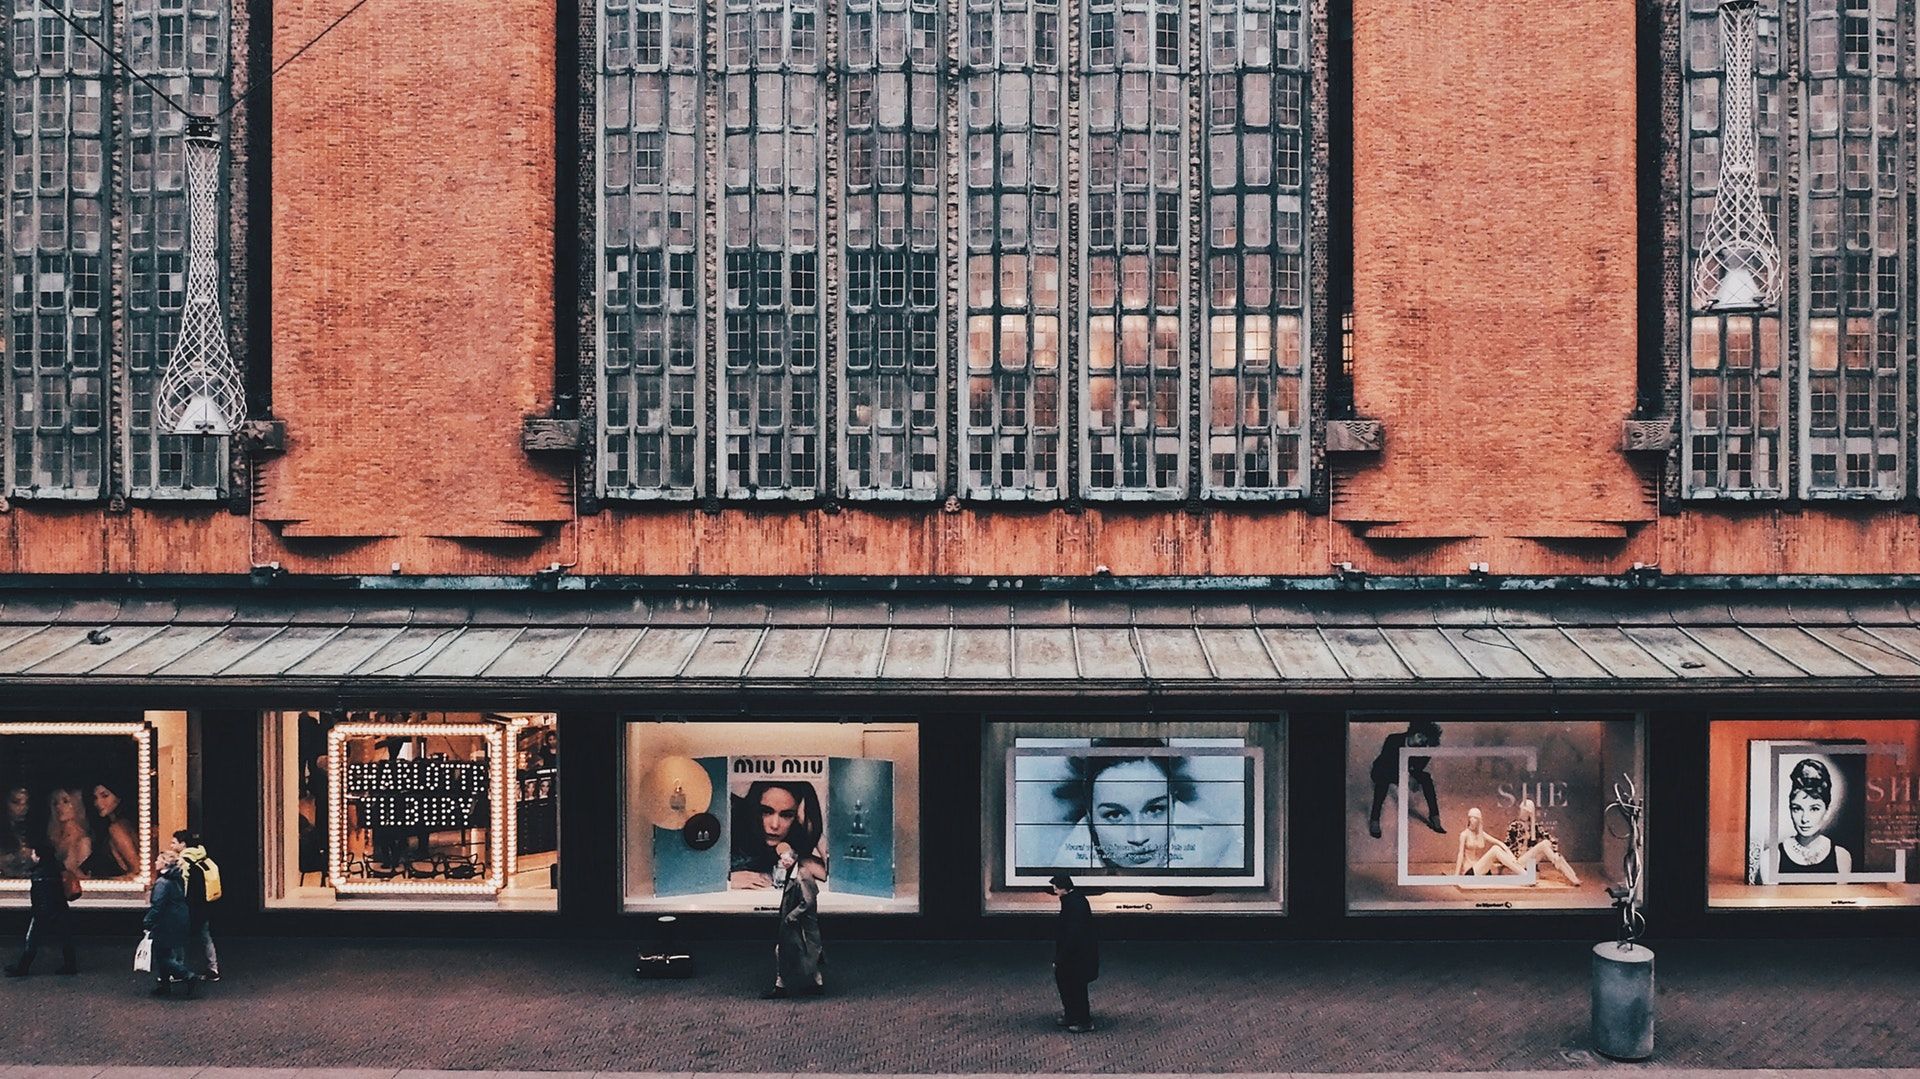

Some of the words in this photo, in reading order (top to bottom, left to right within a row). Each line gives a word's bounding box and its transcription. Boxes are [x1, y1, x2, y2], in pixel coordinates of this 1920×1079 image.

[348, 762, 486, 792] CHARLOTTE
[1866, 777, 1920, 802] SH
[1497, 782, 1568, 808] SHE
[360, 797, 473, 826] TILBURY
